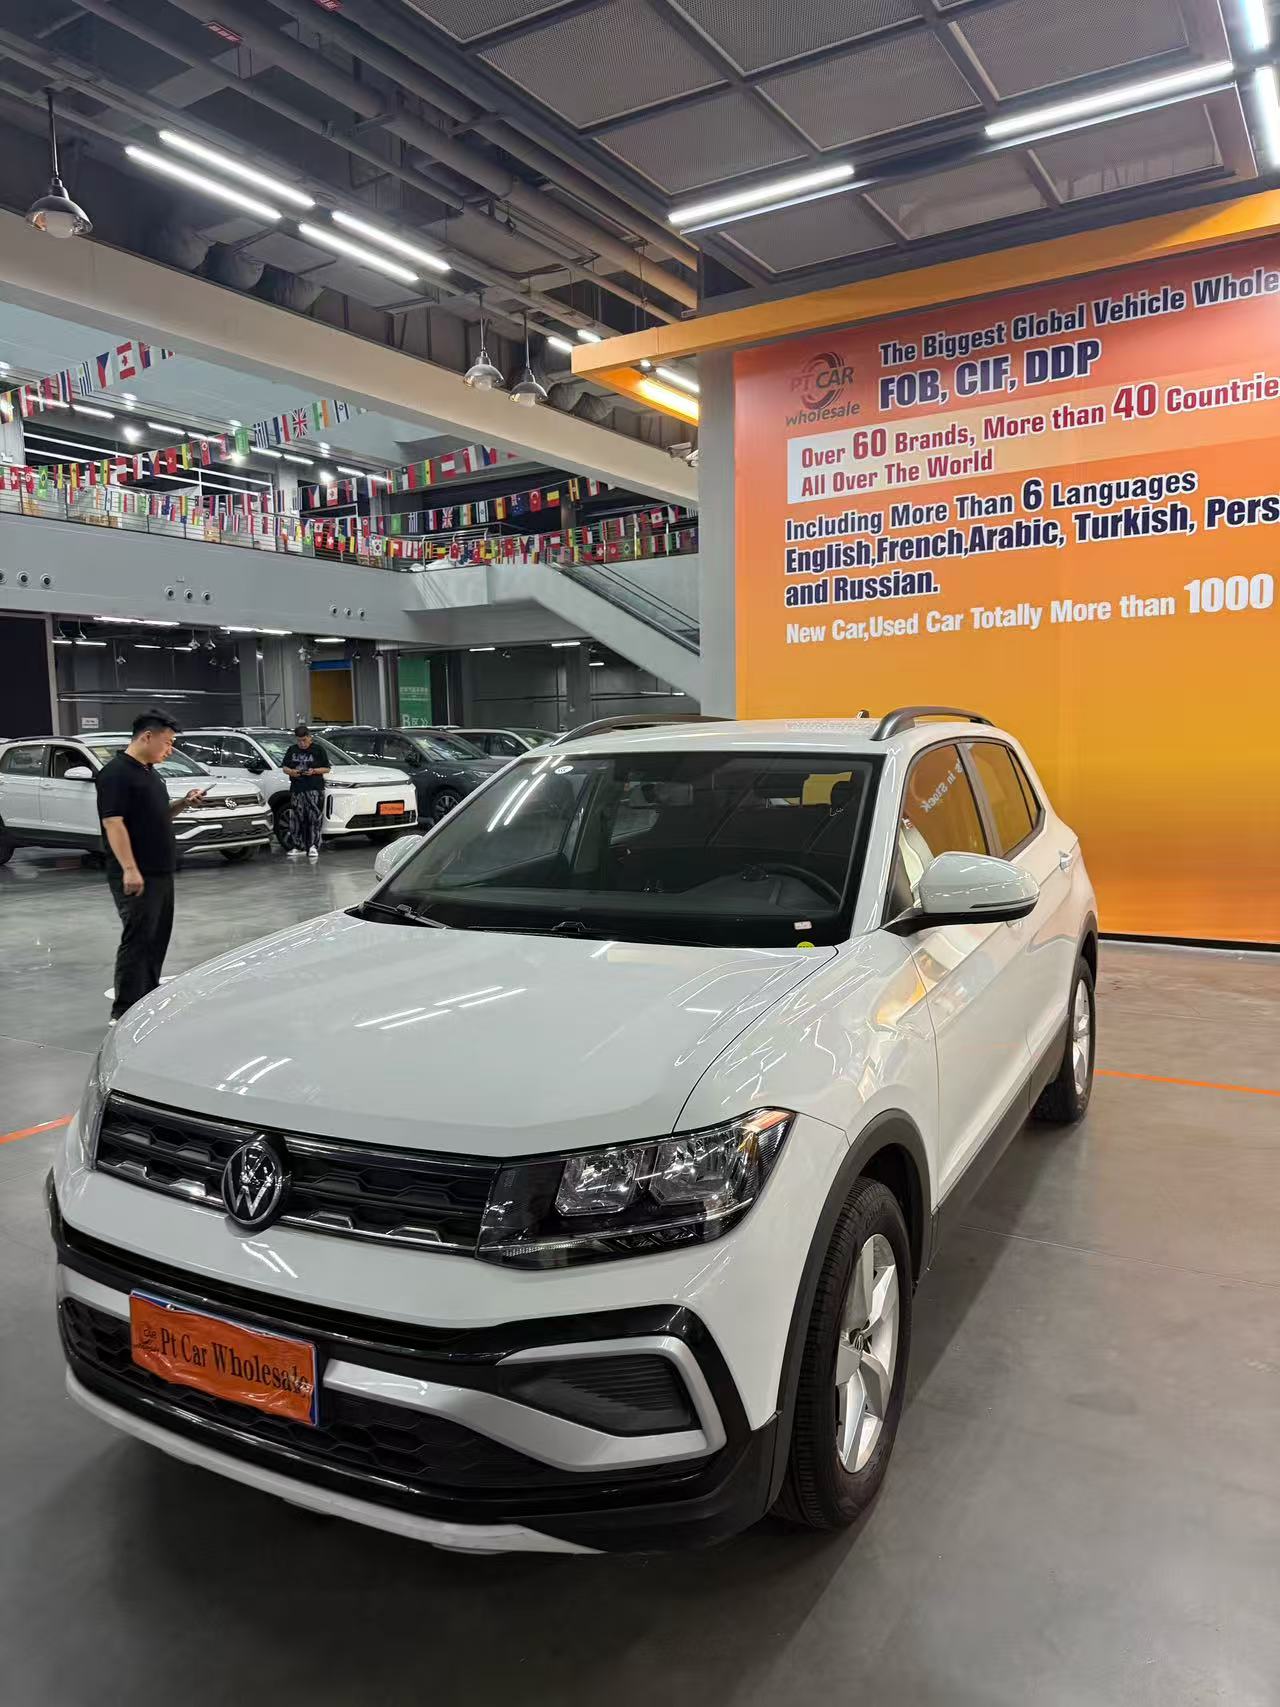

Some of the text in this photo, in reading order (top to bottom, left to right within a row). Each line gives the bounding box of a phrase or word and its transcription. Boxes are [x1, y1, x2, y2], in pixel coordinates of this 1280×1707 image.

[880, 342, 917, 366] The
[923, 323, 1005, 359] Biggest
[1013, 303, 1086, 341] Global
[1093, 287, 1186, 326] Vehicle
[791, 366, 854, 392] PT CAR
[880, 339, 1101, 411] FOB, CIF, DDP
[785, 401, 861, 426] wholesale
[801, 446, 846, 469] Over
[852, 428, 887, 460] 60
[895, 423, 975, 454] Brands,
[983, 415, 1045, 441] More
[1052, 405, 1105, 430] than
[1112, 383, 1158, 420] 40
[785, 471, 1197, 541] Including More Than 6 Languages
[801, 448, 993, 497] All Over The World
[1073, 502, 1196, 542] Turkish,
[785, 570, 940, 607] and Russian.
[786, 624, 826, 644] New
[926, 610, 964, 632] Car
[970, 603, 1043, 631] Totally
[1050, 599, 1112, 623] More
[1119, 594, 1176, 618] than
[1183, 573, 1275, 614] 1000
[161, 1327, 178, 1359] Pt
[181, 1333, 208, 1368] Car
[211, 1342, 312, 1398] Wholesale
